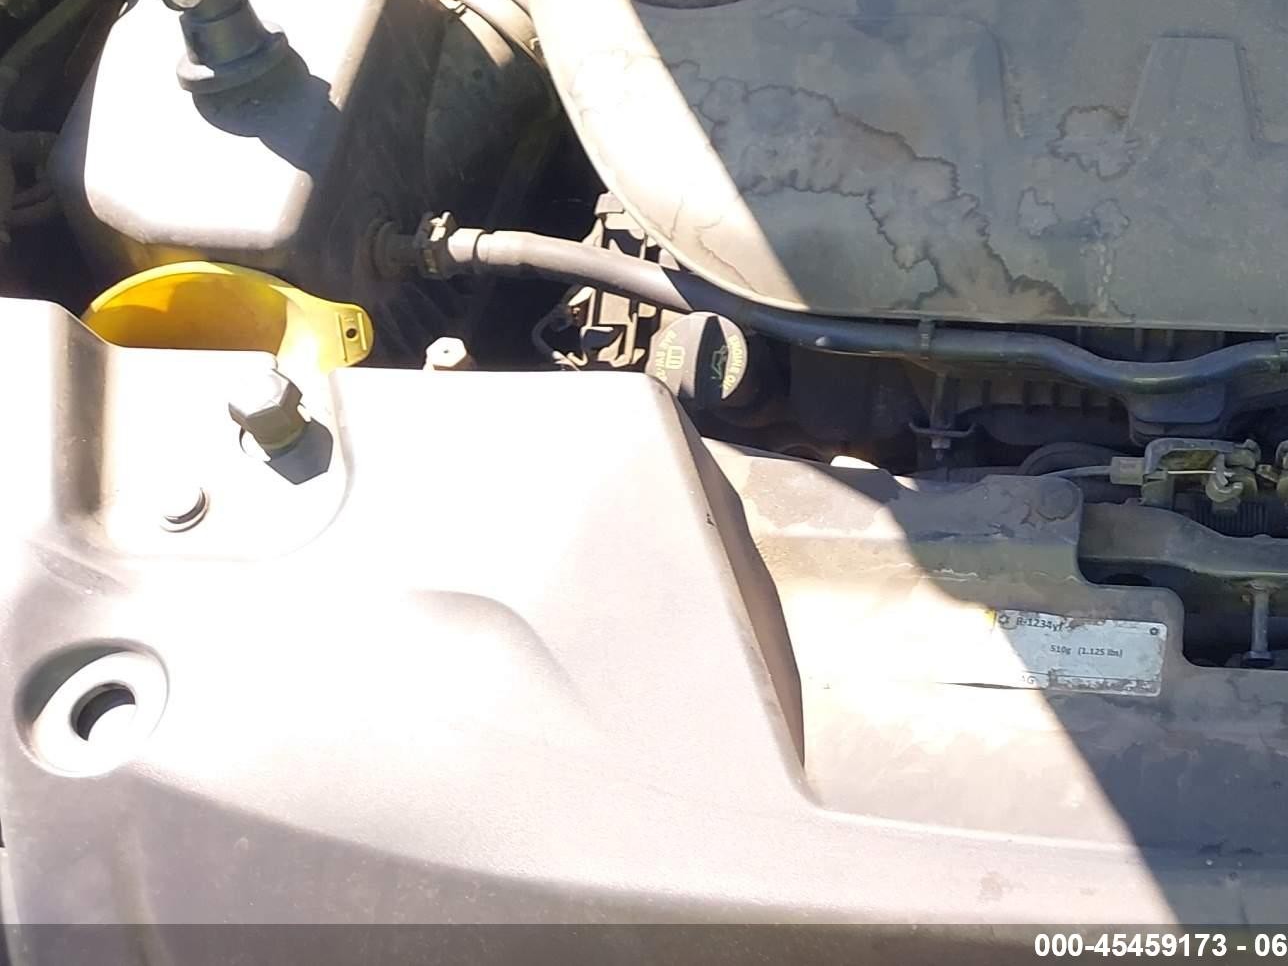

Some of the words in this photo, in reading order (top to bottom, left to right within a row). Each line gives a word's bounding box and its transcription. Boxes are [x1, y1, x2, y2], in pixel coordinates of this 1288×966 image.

[1051, 644, 1071, 655] 510g
[1078, 646, 1105, 657] (1.125
[1107, 648, 1123, 658] lbs)
